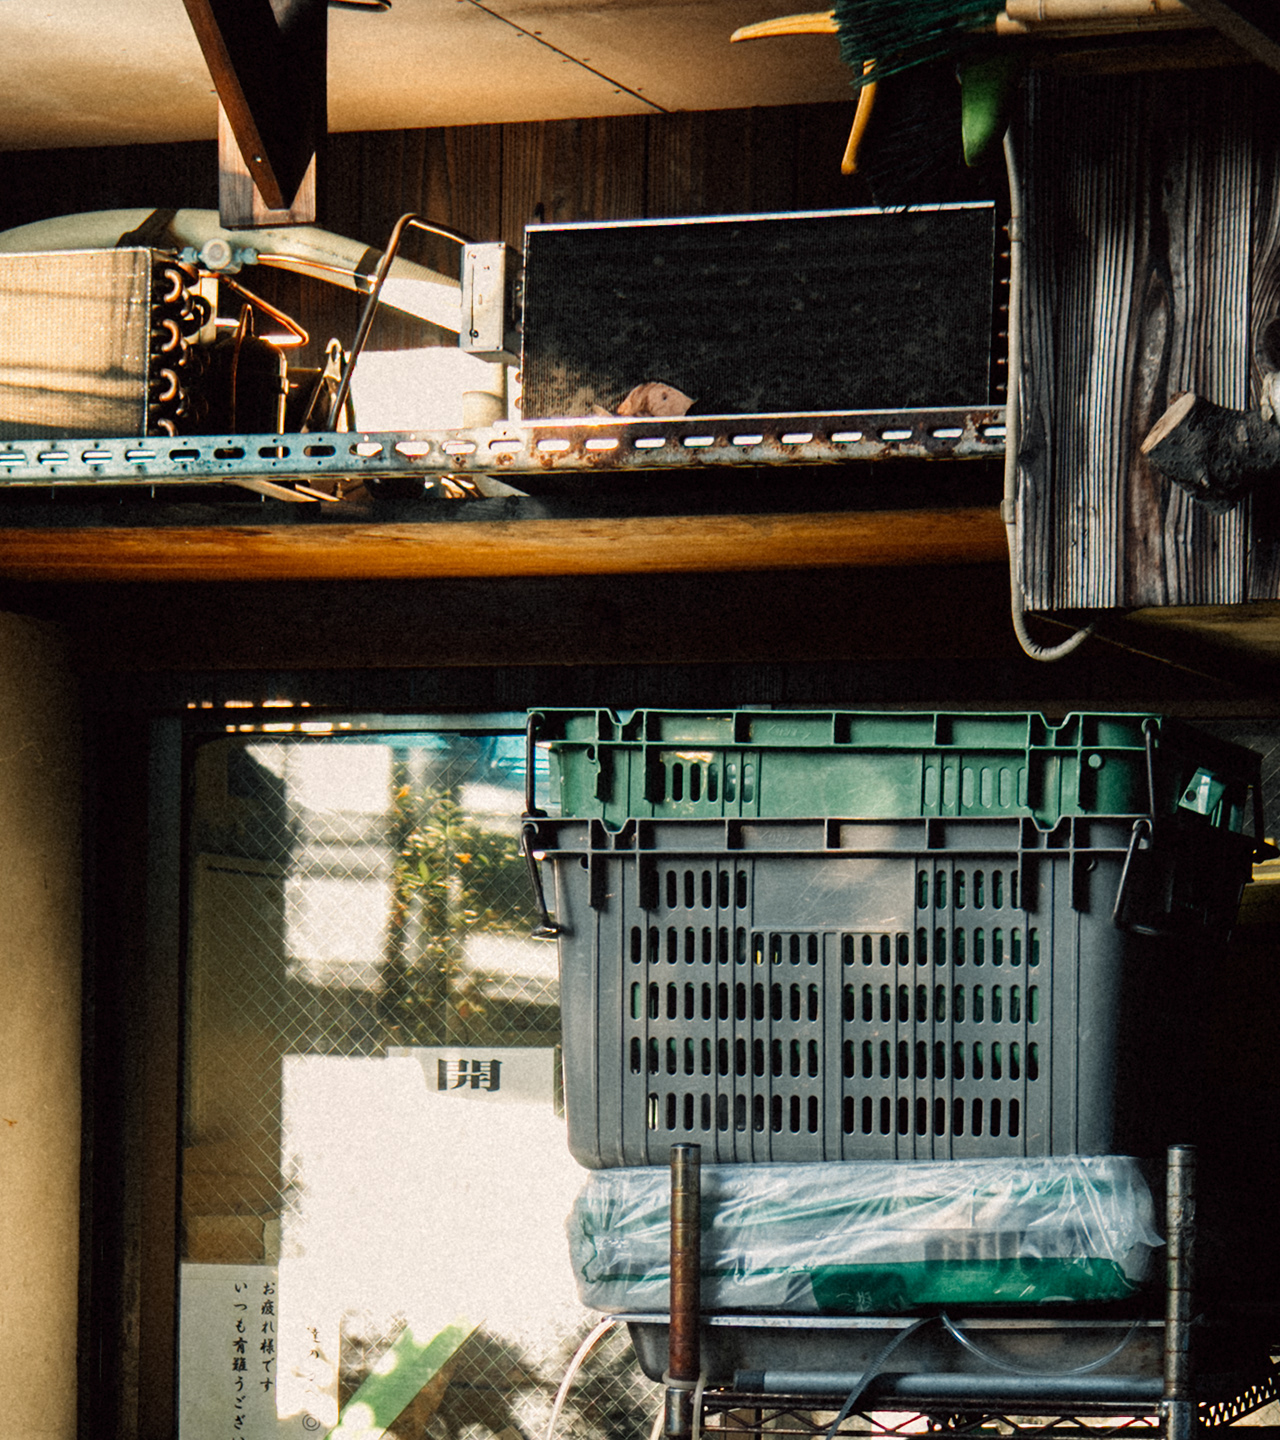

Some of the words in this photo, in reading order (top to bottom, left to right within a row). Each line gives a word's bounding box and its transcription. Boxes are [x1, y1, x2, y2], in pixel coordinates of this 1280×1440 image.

[438, 1058, 503, 1092] 開
[260, 1281, 276, 1392] お疲れ様です
